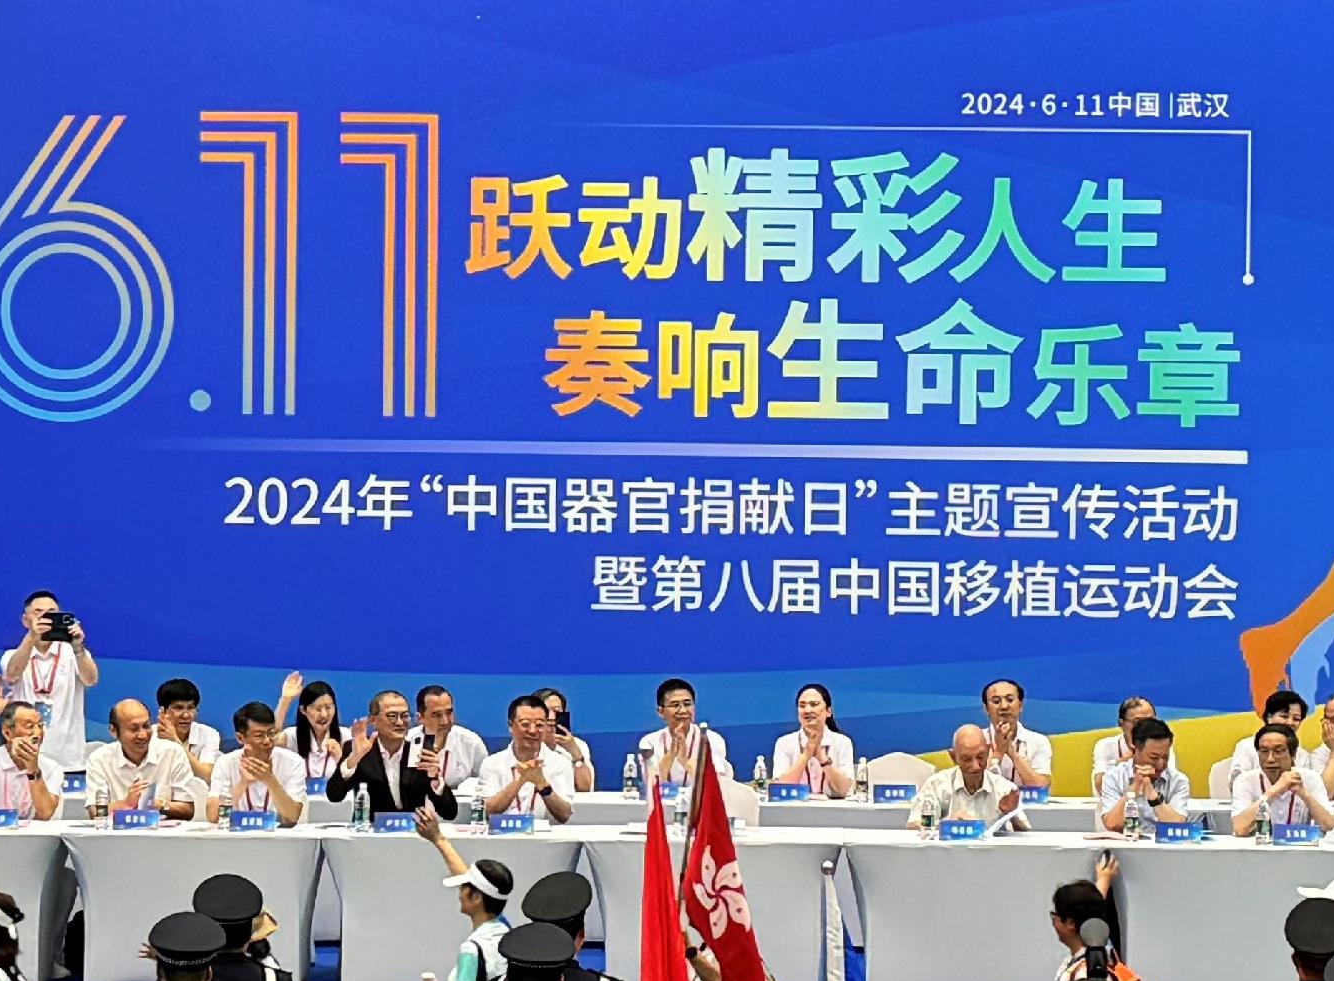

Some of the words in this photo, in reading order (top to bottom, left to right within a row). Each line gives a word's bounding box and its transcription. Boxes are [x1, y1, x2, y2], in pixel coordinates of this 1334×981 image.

[464, 146, 1167, 285] 跃动精彩人生
[542, 297, 1242, 429] 奏响生命乐章
[224, 473, 1239, 542] 2024年“中国器官捐献日”主题宣传活动
[589, 553, 1239, 621] 暨第八届中国移植运动会
